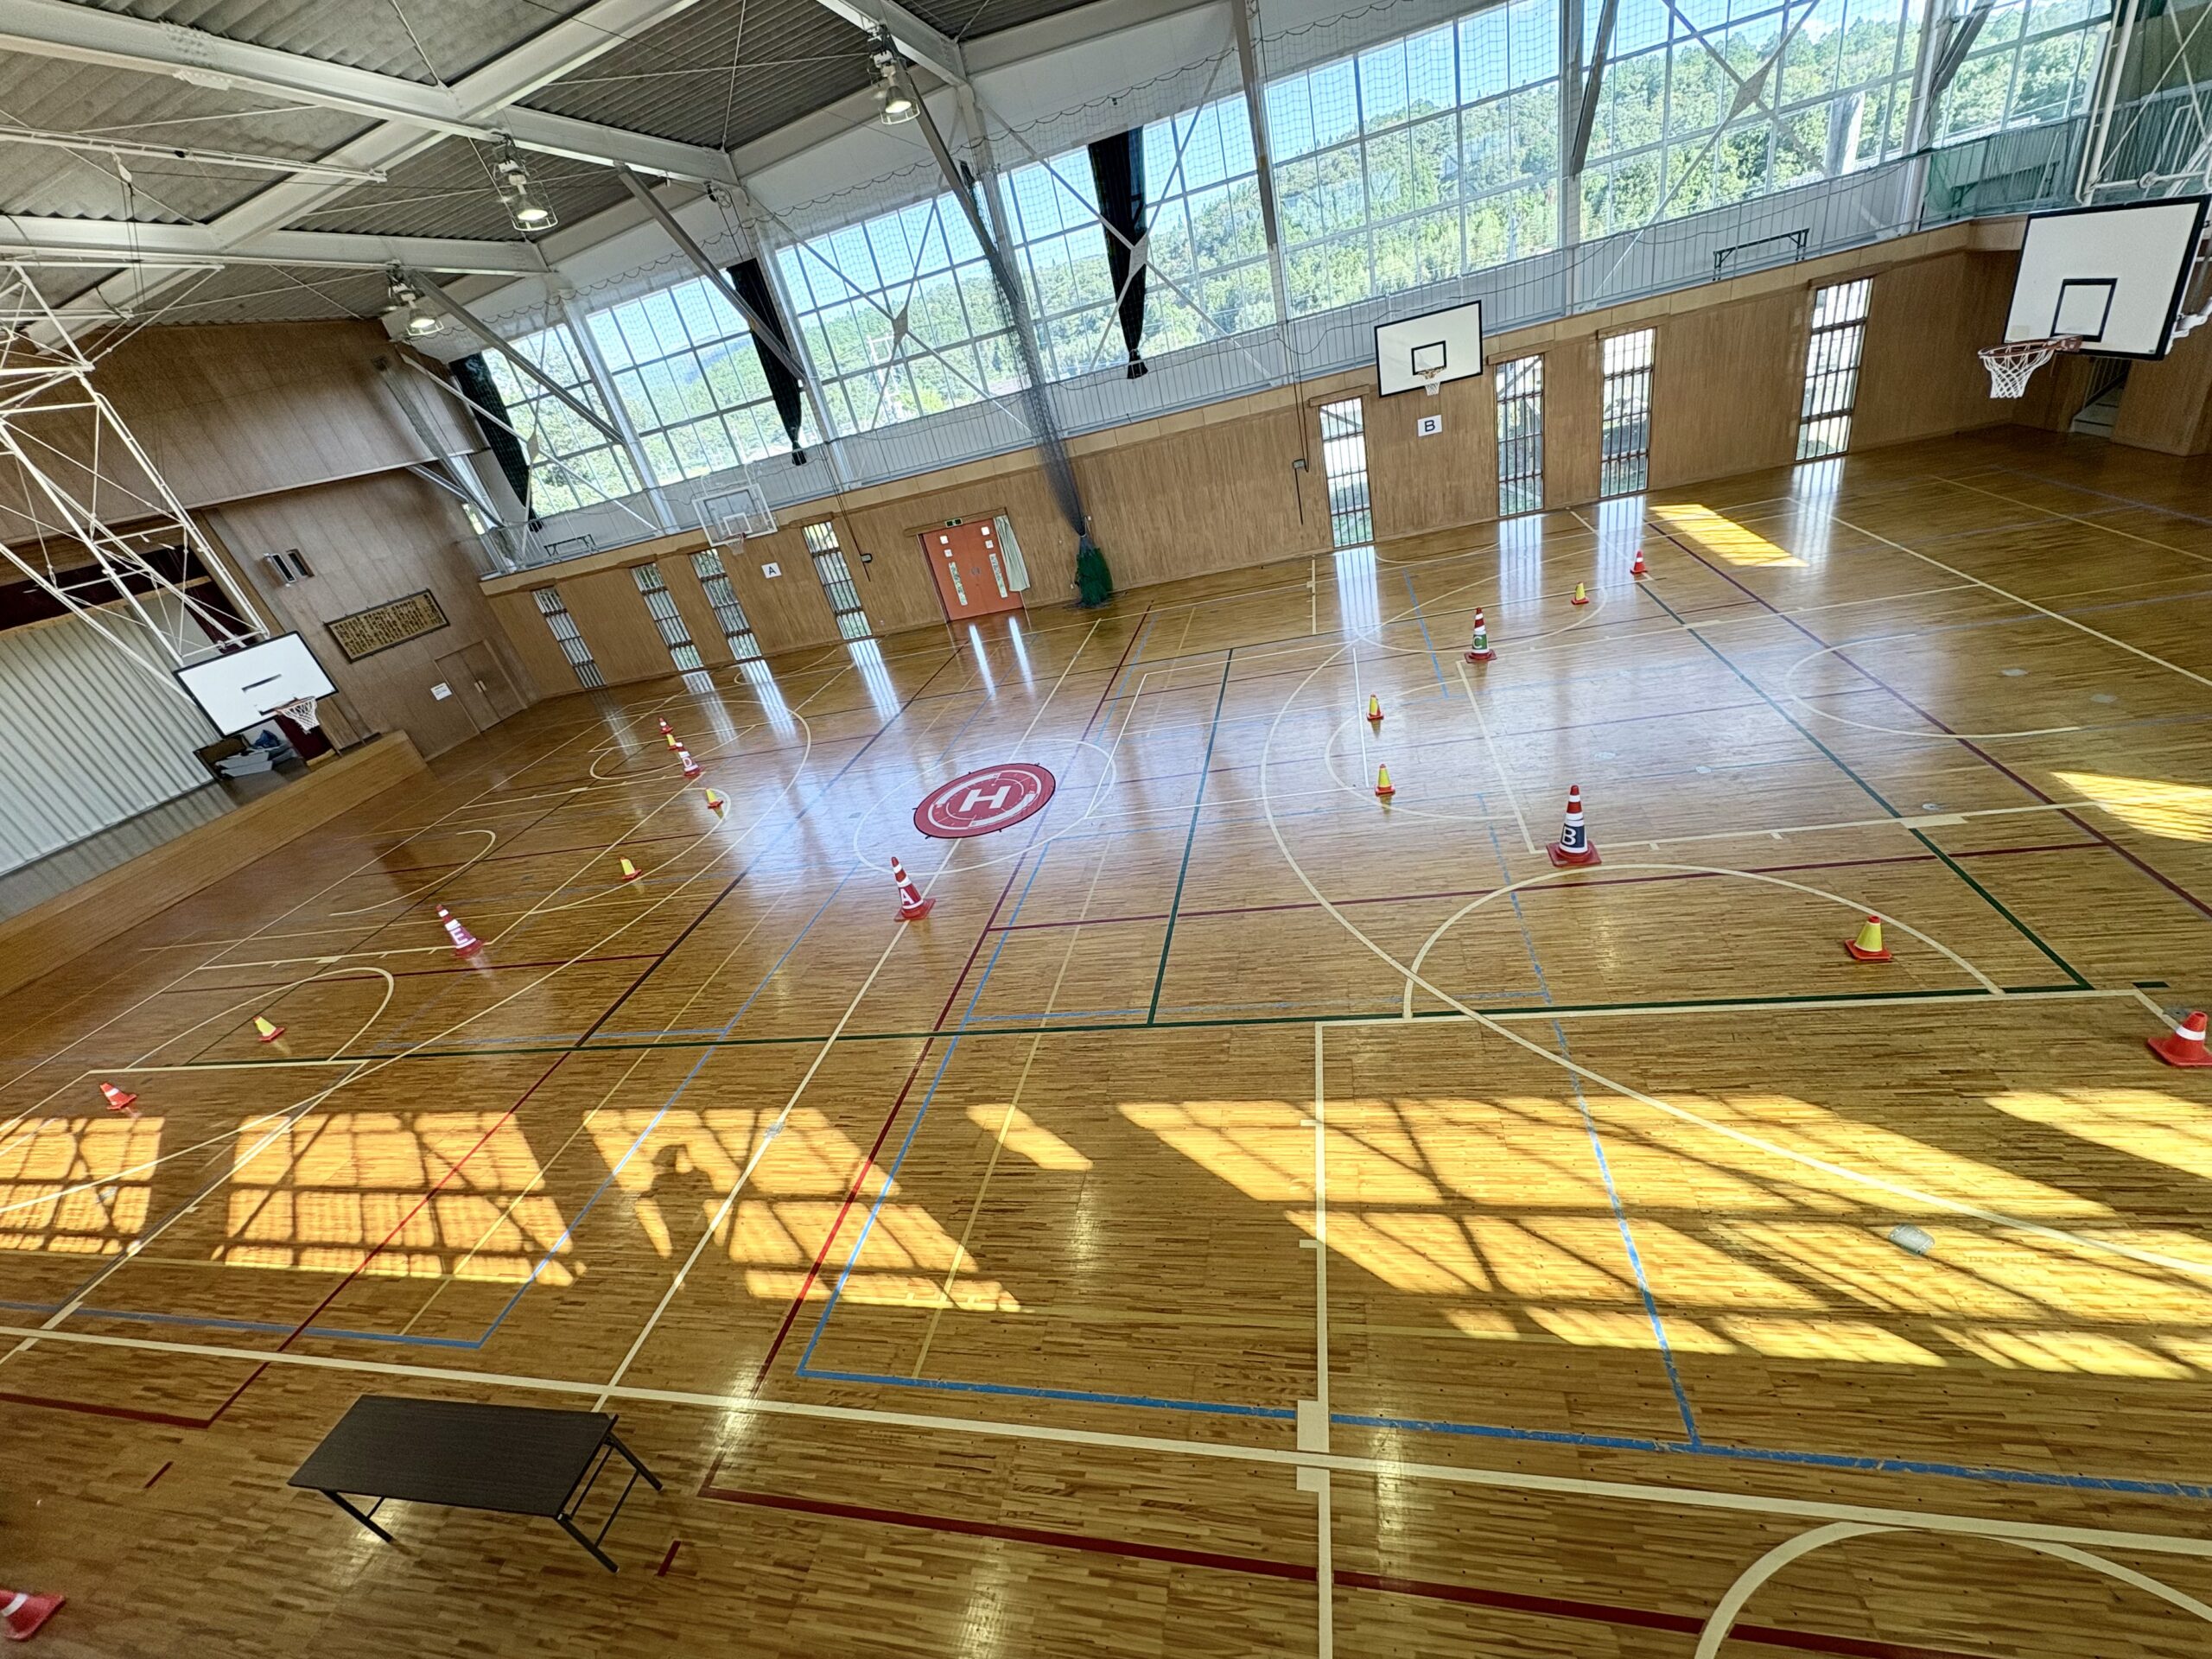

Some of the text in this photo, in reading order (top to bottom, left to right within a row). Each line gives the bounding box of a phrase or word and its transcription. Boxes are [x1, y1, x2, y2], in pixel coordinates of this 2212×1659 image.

[1425, 419, 1435, 432] B
[769, 566, 777, 575] A
[1473, 636, 1483, 649] C
[683, 757, 693, 768] D
[958, 785, 1011, 812] H
[1562, 826, 1576, 845] B
[900, 888, 914, 905] A
[449, 928, 468, 944] E
